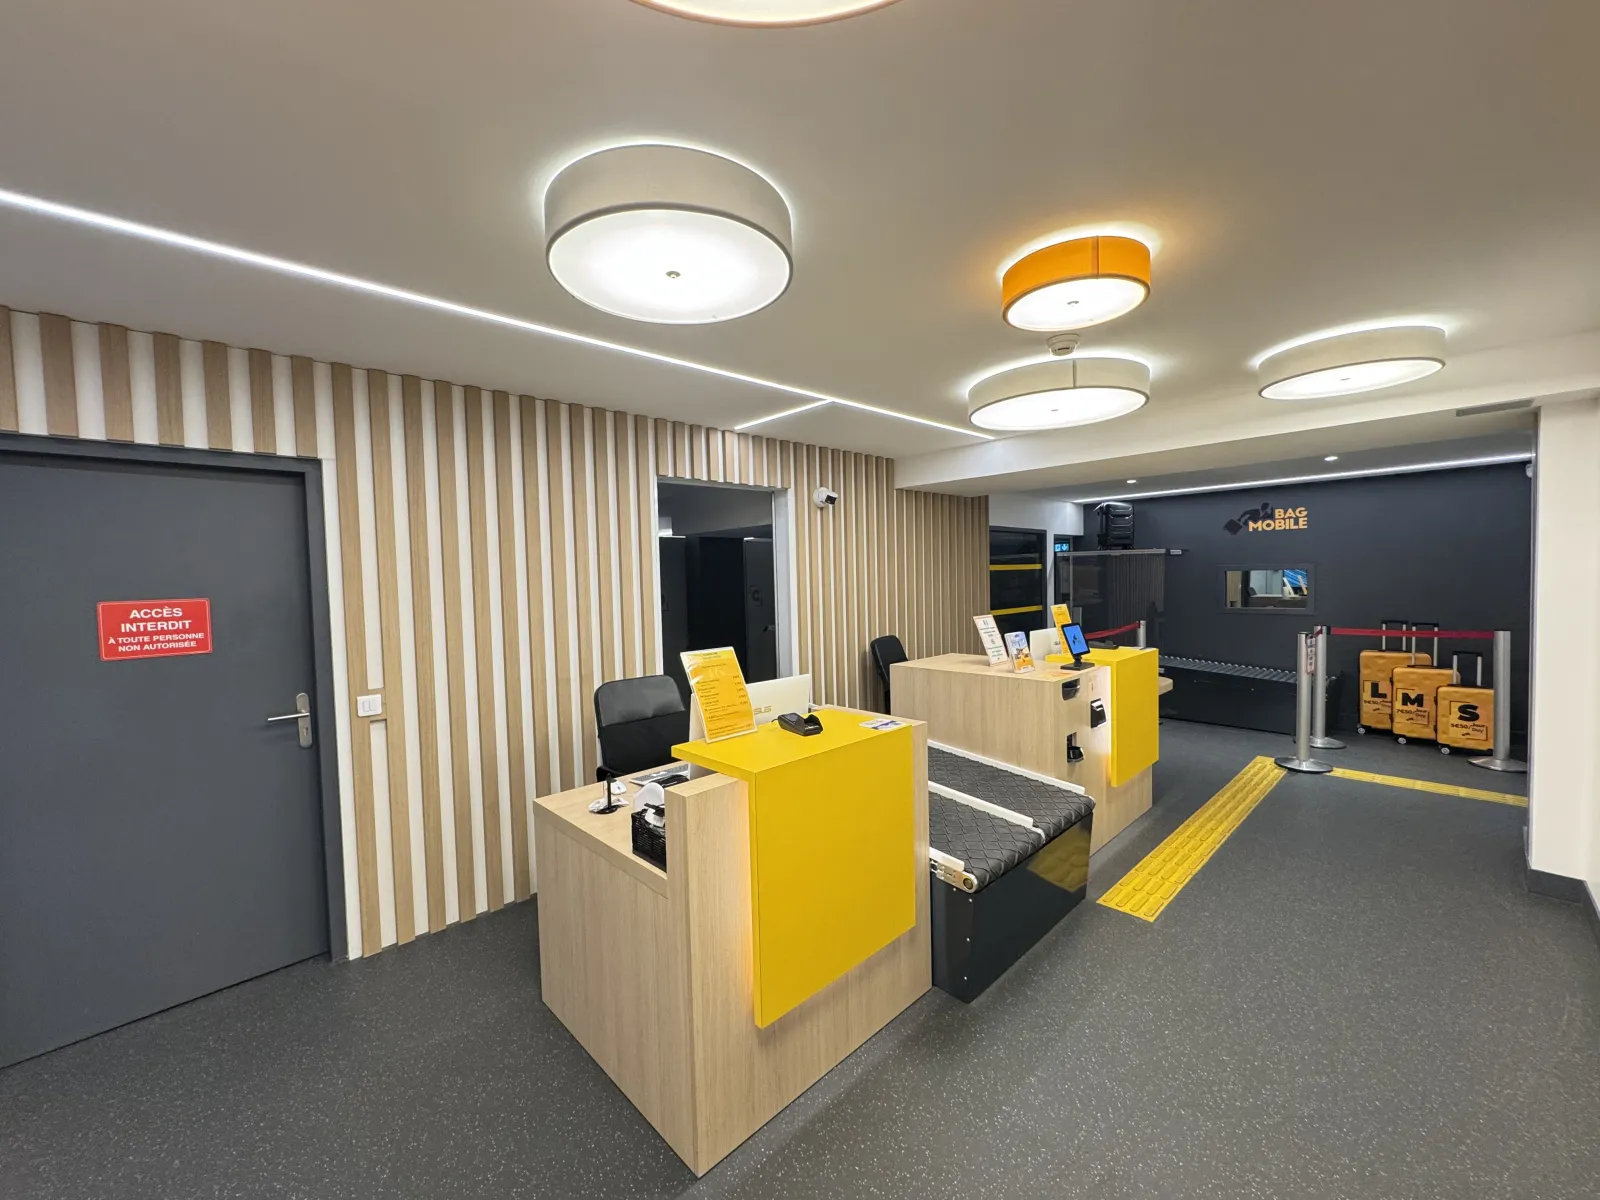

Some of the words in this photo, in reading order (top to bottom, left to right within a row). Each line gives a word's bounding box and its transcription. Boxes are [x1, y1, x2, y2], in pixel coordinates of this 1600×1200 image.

[1274, 507, 1308, 519] BAG
[1248, 518, 1308, 532] MOBILE
[129, 606, 183, 619] ACCÈS
[121, 620, 192, 633] INTERDIT
[117, 635, 150, 644] TOUTE
[152, 632, 205, 643] PERSONNE
[143, 640, 197, 651] AUTORISÉE
[1370, 682, 1387, 699] L
[1401, 692, 1424, 708] M
[753, 705, 772, 716] SUS
[1457, 703, 1480, 722] S
